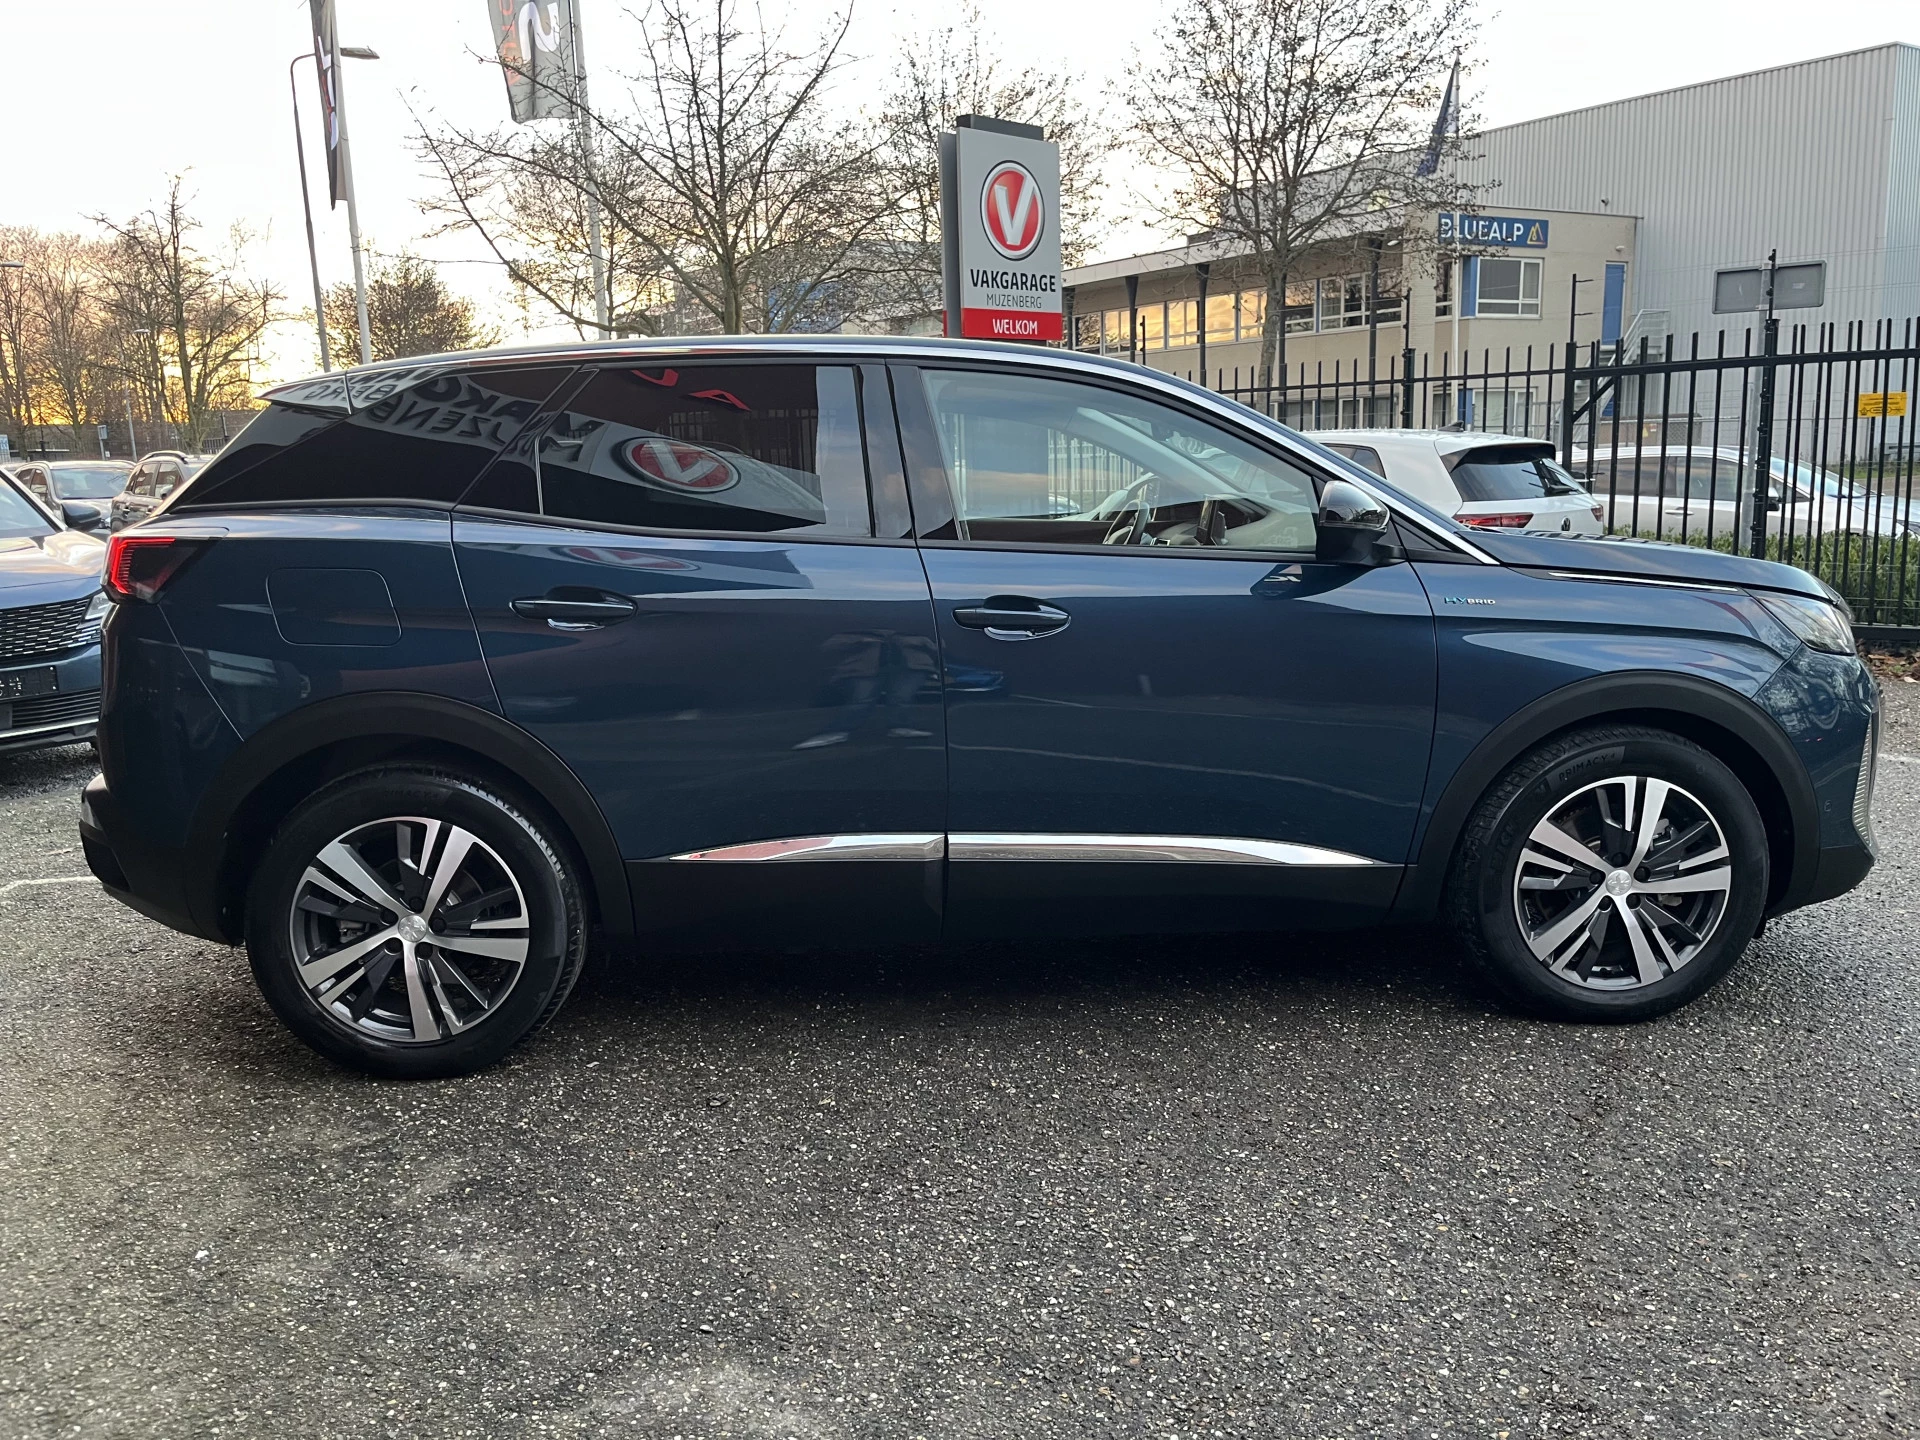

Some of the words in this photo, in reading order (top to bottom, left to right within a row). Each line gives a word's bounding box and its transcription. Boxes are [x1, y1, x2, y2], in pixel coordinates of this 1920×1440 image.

[970, 268, 1056, 293] VAKGARAGE
[986, 293, 1042, 308] MUZENBERG
[992, 318, 1038, 335] WELKOM
[1444, 597, 1496, 605] HYBRID
